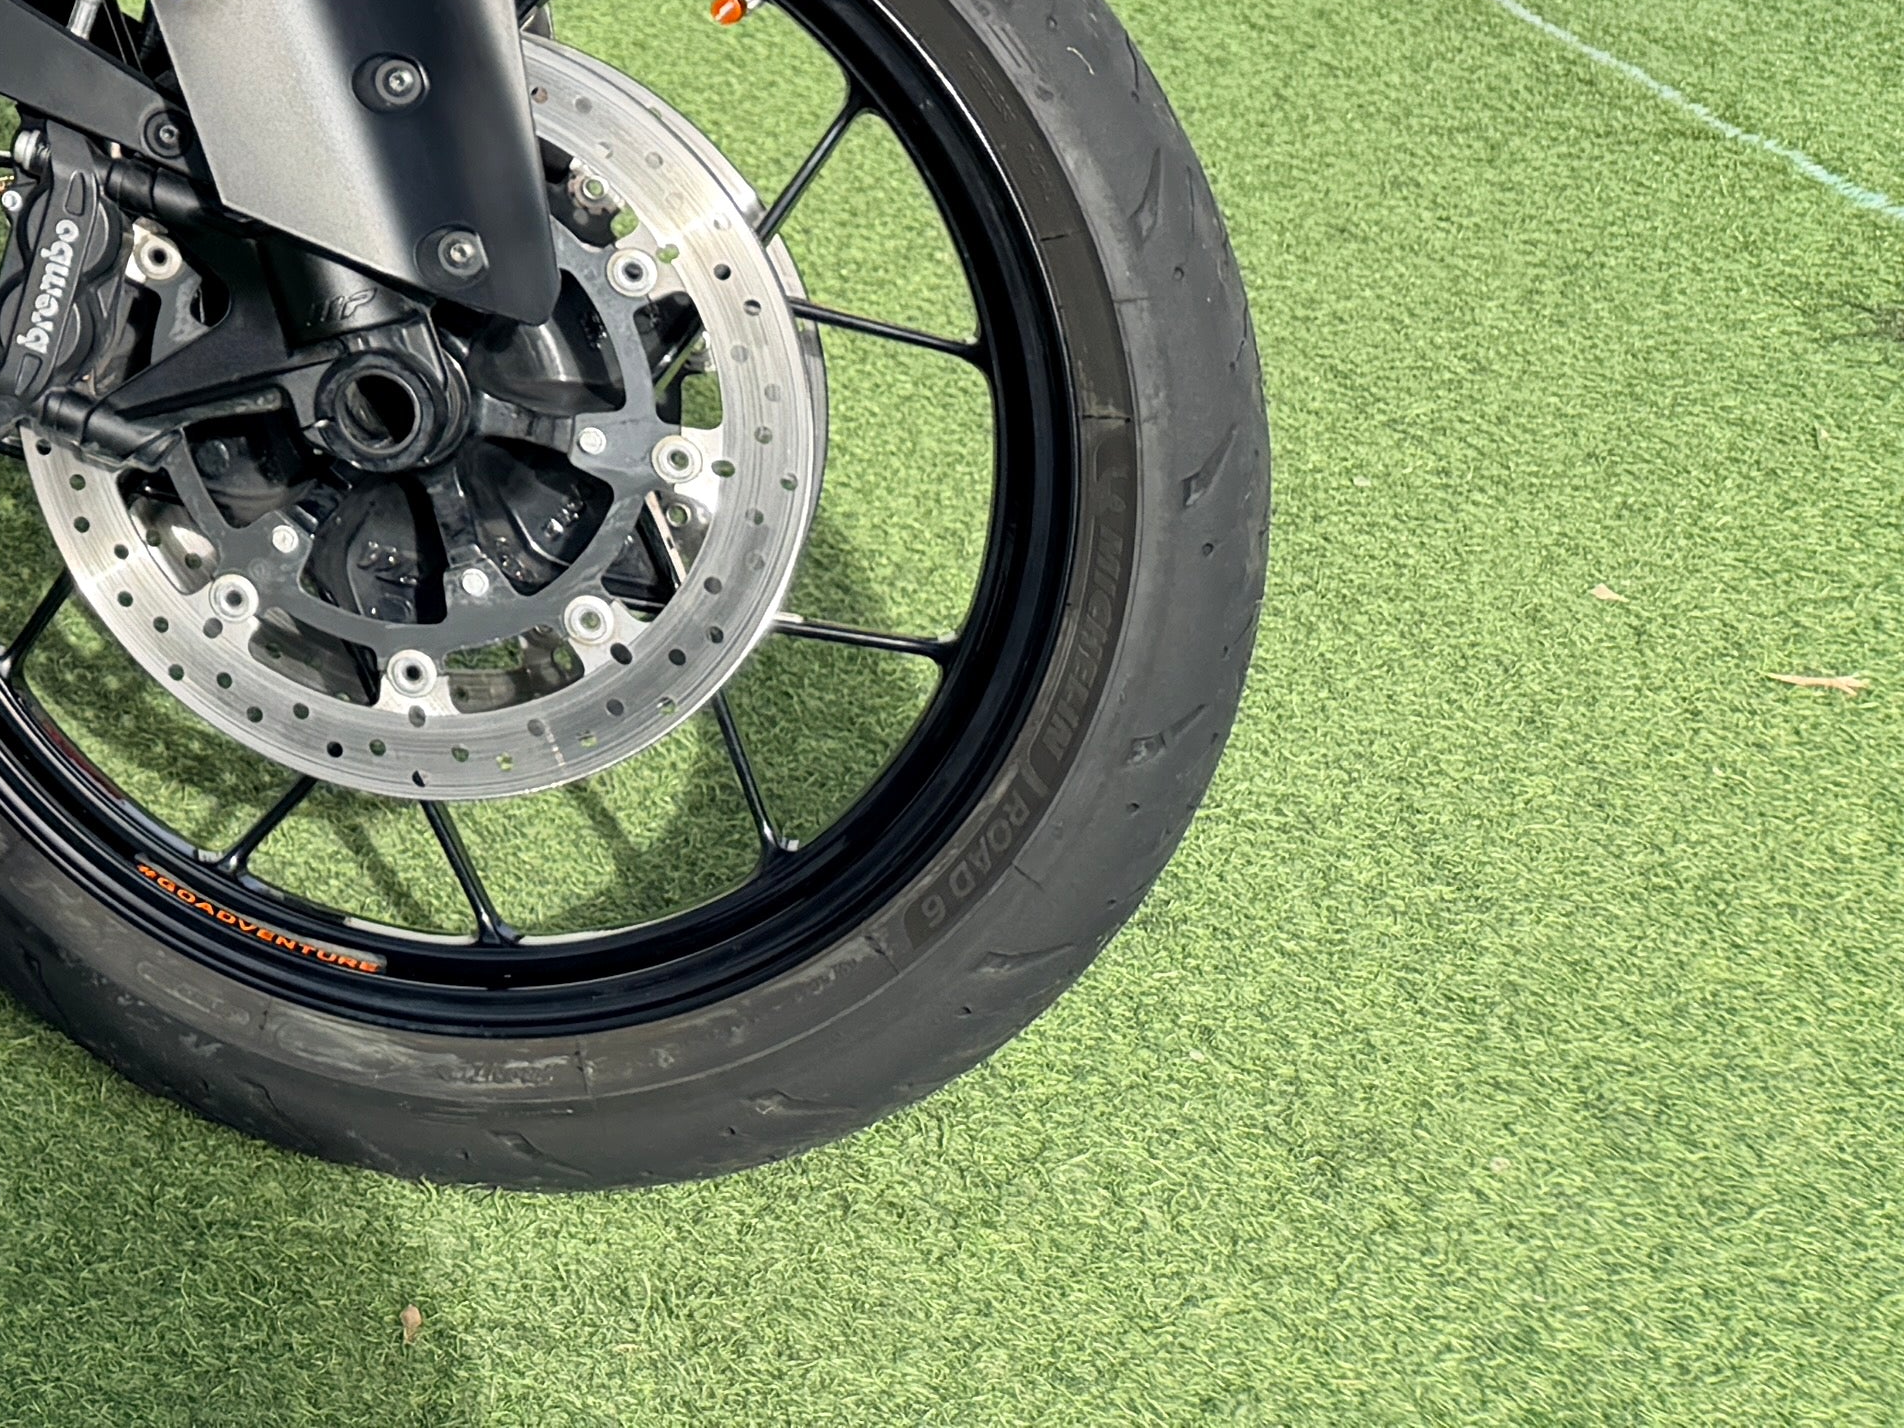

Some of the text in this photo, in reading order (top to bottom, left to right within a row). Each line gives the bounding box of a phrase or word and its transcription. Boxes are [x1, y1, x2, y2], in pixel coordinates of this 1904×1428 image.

[16, 218, 80, 354] brembo
[1042, 523, 1124, 762] MICHELIN
[136, 863, 380, 974] #GOADVENTURE
[921, 793, 1033, 931] ROAD 6
